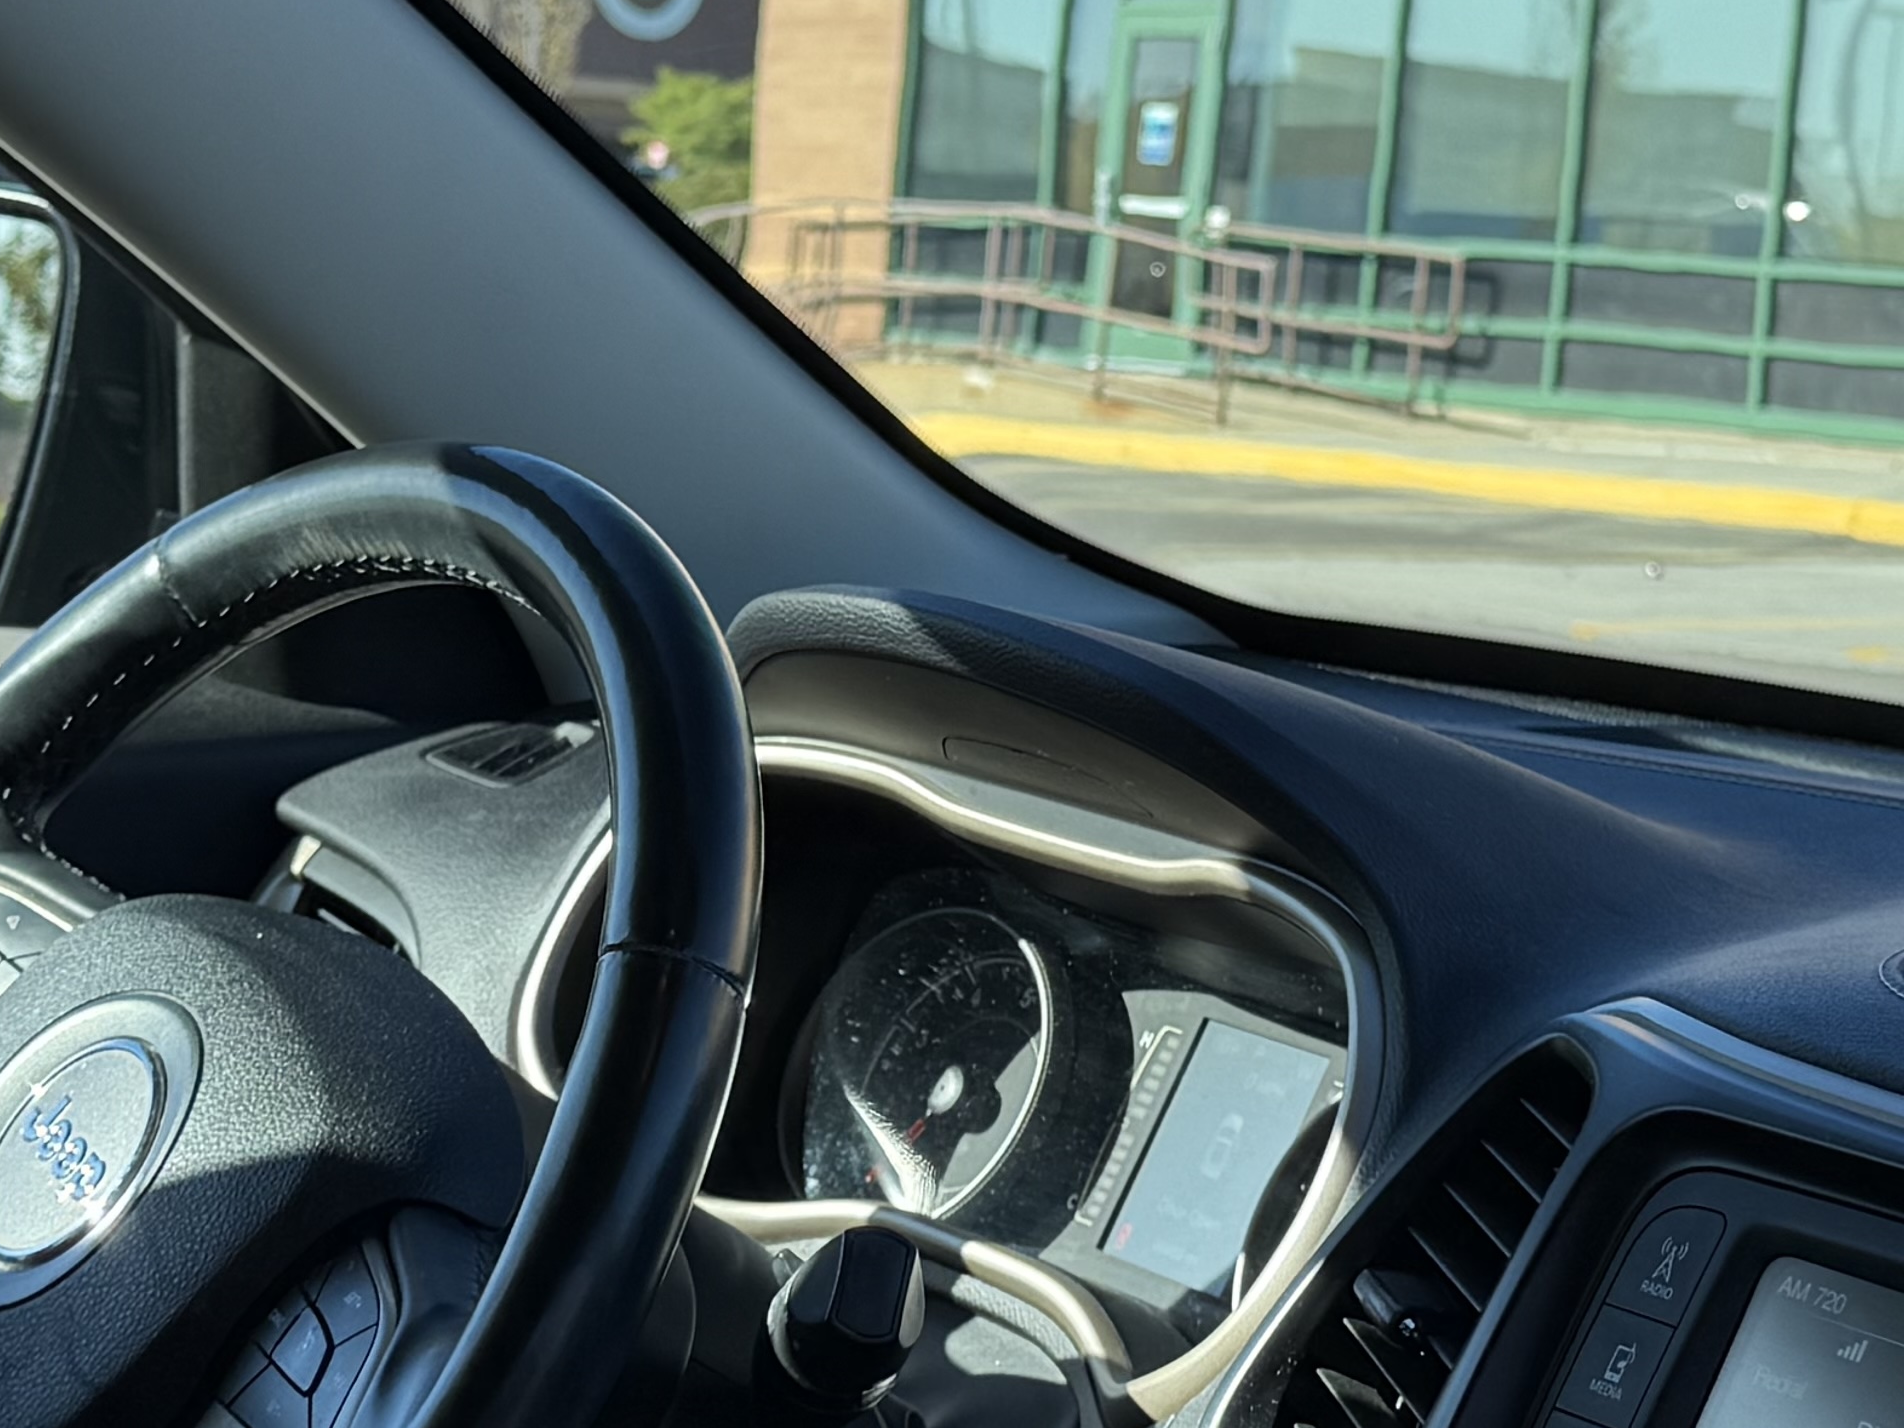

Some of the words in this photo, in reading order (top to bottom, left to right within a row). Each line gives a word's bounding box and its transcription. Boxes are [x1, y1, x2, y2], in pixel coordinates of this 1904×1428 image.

[22, 1094, 106, 1204] Jeep
[1639, 1278, 1675, 1301] RADIO
[1777, 1274, 1810, 1303] AM
[1812, 1285, 1848, 1315] 720
[1588, 1378, 1624, 1402] MEDIA
